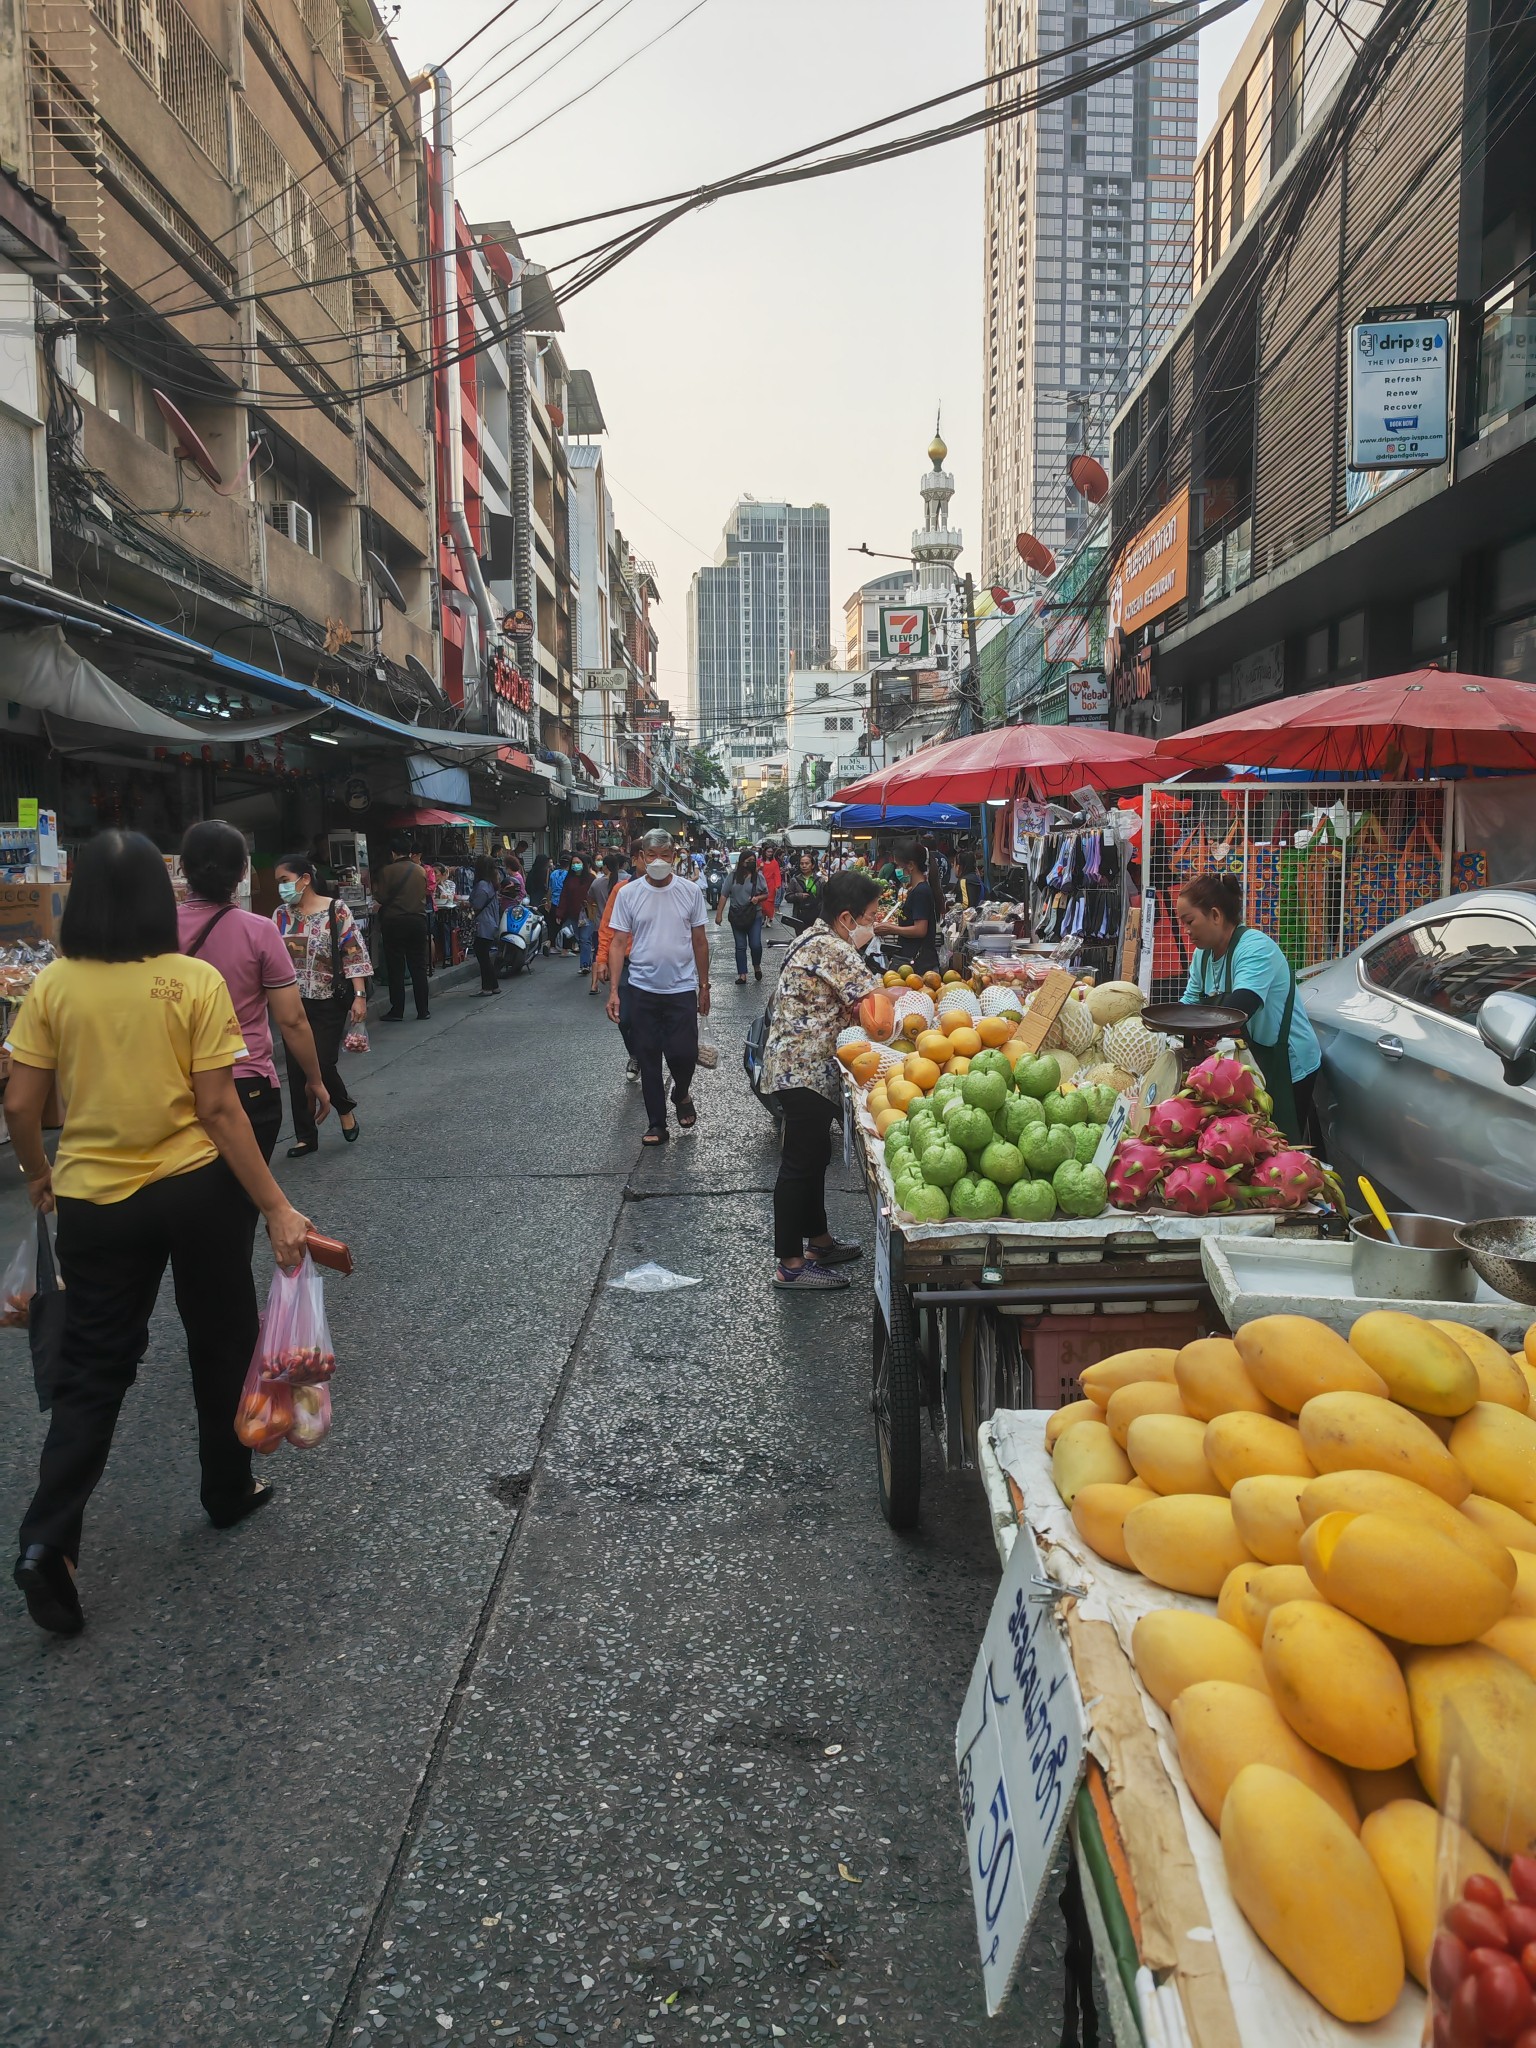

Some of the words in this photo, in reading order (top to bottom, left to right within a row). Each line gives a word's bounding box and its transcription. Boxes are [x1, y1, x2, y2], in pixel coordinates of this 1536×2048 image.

[1380, 334, 1414, 353] drip
[1421, 355, 1438, 363] SPA
[1384, 375, 1422, 384] Refresh
[1386, 389, 1418, 397] Renew
[1383, 403, 1423, 411] Recover
[587, 674, 614, 689] BLESS
[1081, 689, 1108, 701] kebab
[1081, 700, 1098, 711] box
[153, 976, 166, 987] To
[169, 978, 185, 990] Be
[149, 987, 184, 1003] good
[977, 1774, 1015, 1932] 50
